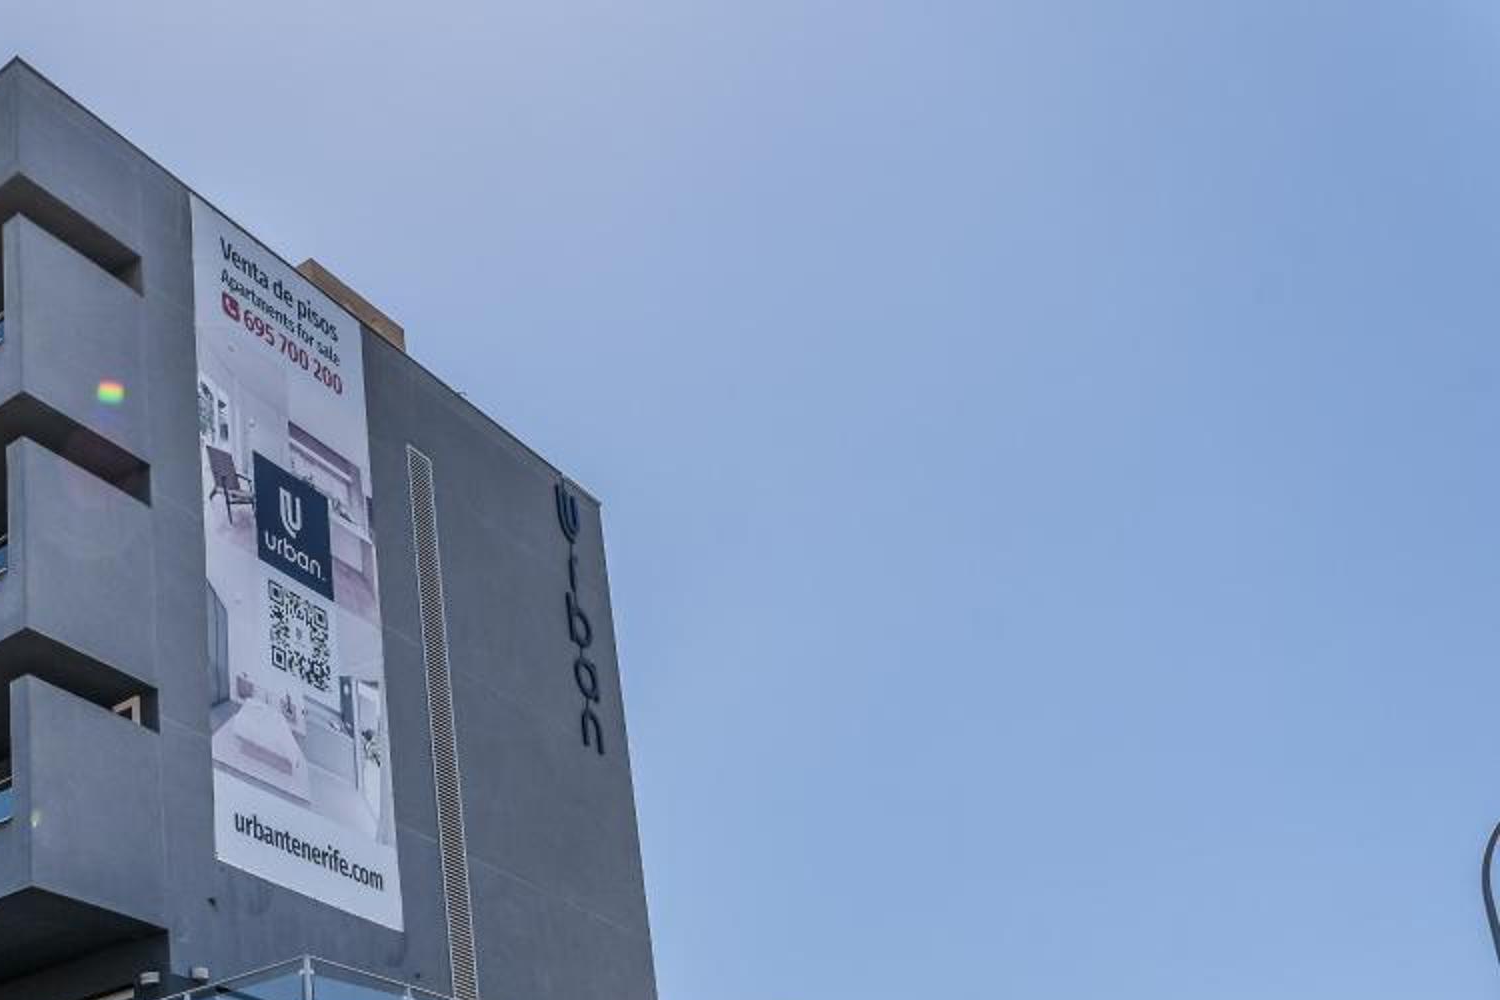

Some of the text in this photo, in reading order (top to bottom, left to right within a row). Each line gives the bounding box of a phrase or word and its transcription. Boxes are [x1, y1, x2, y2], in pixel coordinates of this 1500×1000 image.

[220, 235, 339, 342] Venta de pisos
[221, 268, 340, 367] Apartments for sale
[243, 309, 343, 396] 695 700 200
[234, 812, 383, 891] urbantenerife.com
